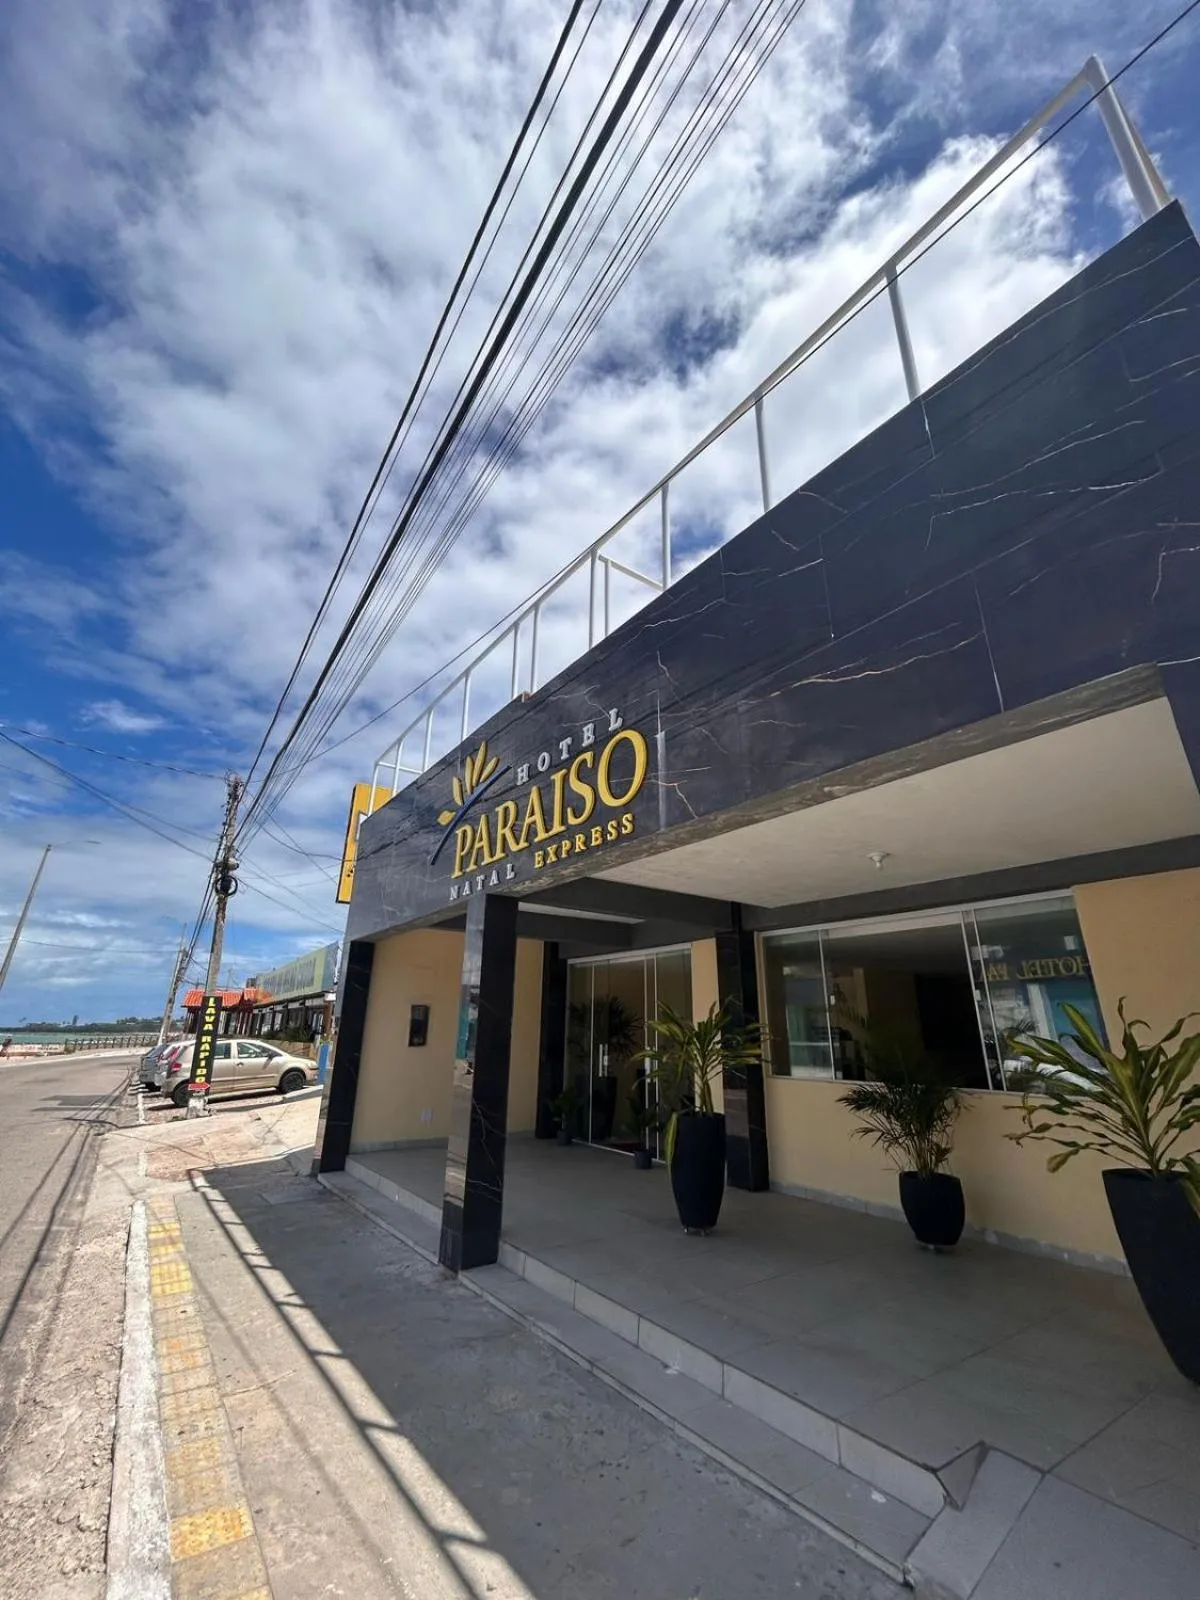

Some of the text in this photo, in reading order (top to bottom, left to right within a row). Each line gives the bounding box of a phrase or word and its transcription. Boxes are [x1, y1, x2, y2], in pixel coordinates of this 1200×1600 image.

[516, 707, 623, 786] HOTEL
[451, 728, 648, 879] PARAISO
[450, 812, 635, 900] NATAL EXPRESS
[203, 997, 216, 1031] LAVA
[195, 1035, 212, 1084] RAPIDO
